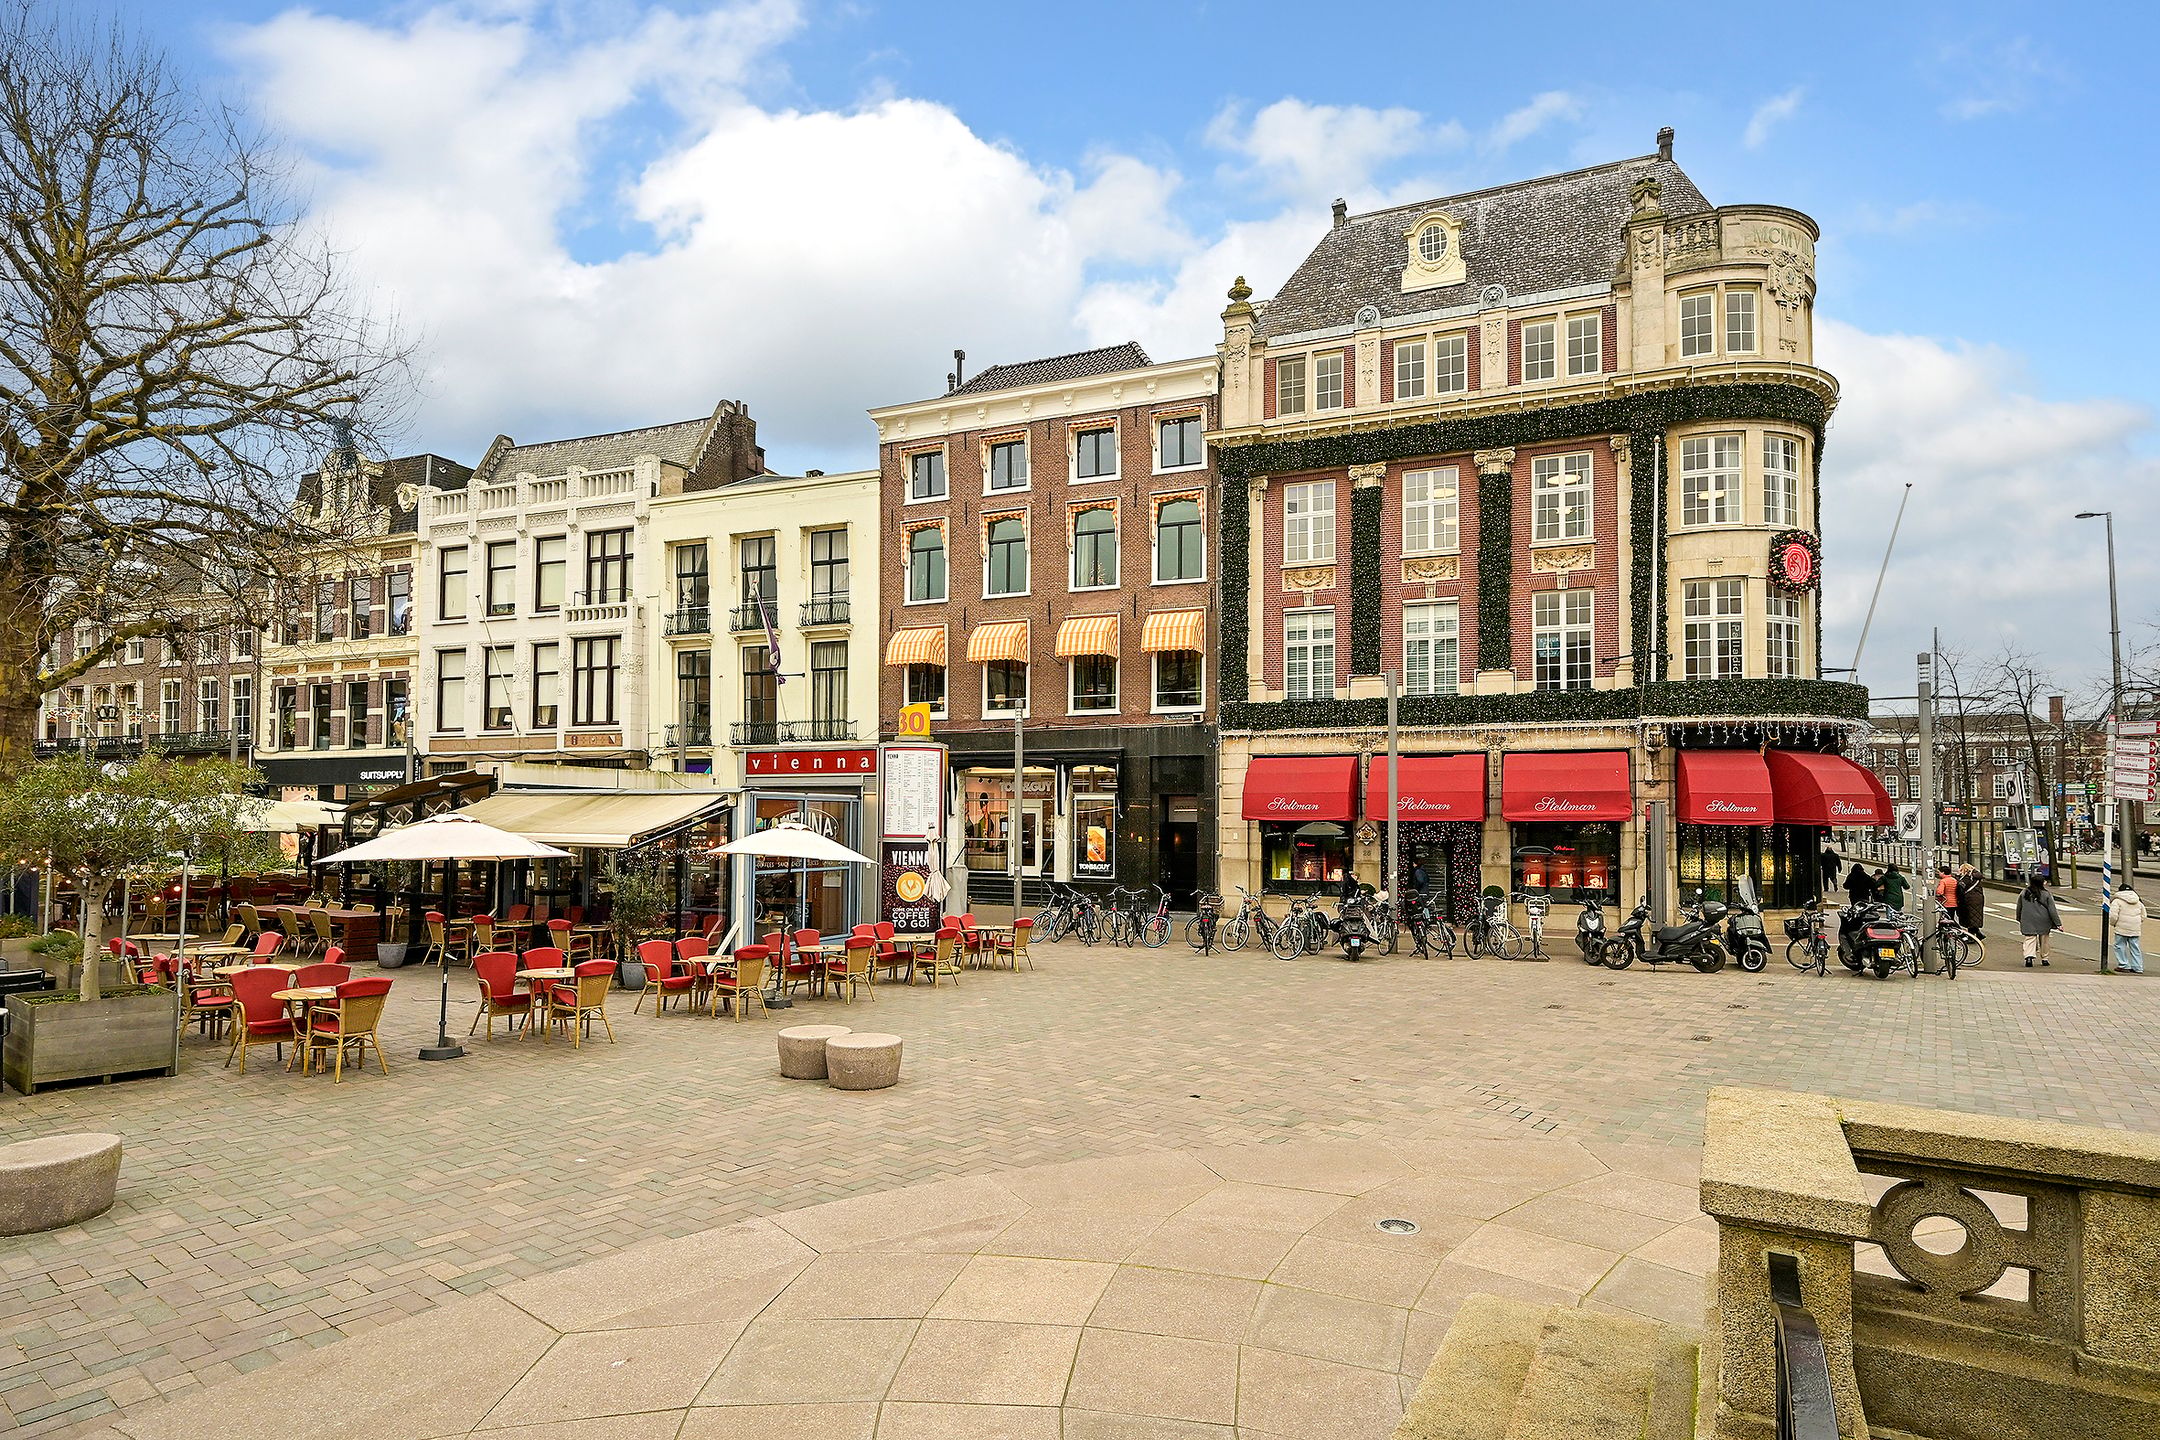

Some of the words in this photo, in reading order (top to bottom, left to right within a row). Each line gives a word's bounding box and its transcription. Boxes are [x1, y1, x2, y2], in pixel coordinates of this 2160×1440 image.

[752, 754, 870, 770] vienna
[360, 770, 405, 780] SUITSUPPLY
[1267, 797, 1320, 811] Steltman
[1397, 797, 1451, 811] Steltman
[1534, 797, 1597, 812] Steltman
[1706, 800, 1757, 813] Steltman
[1831, 800, 1873, 815] Steltman
[892, 911, 930, 920] COFFEE
[892, 919, 907, 929] TO
[910, 919, 930, 929] GO!
